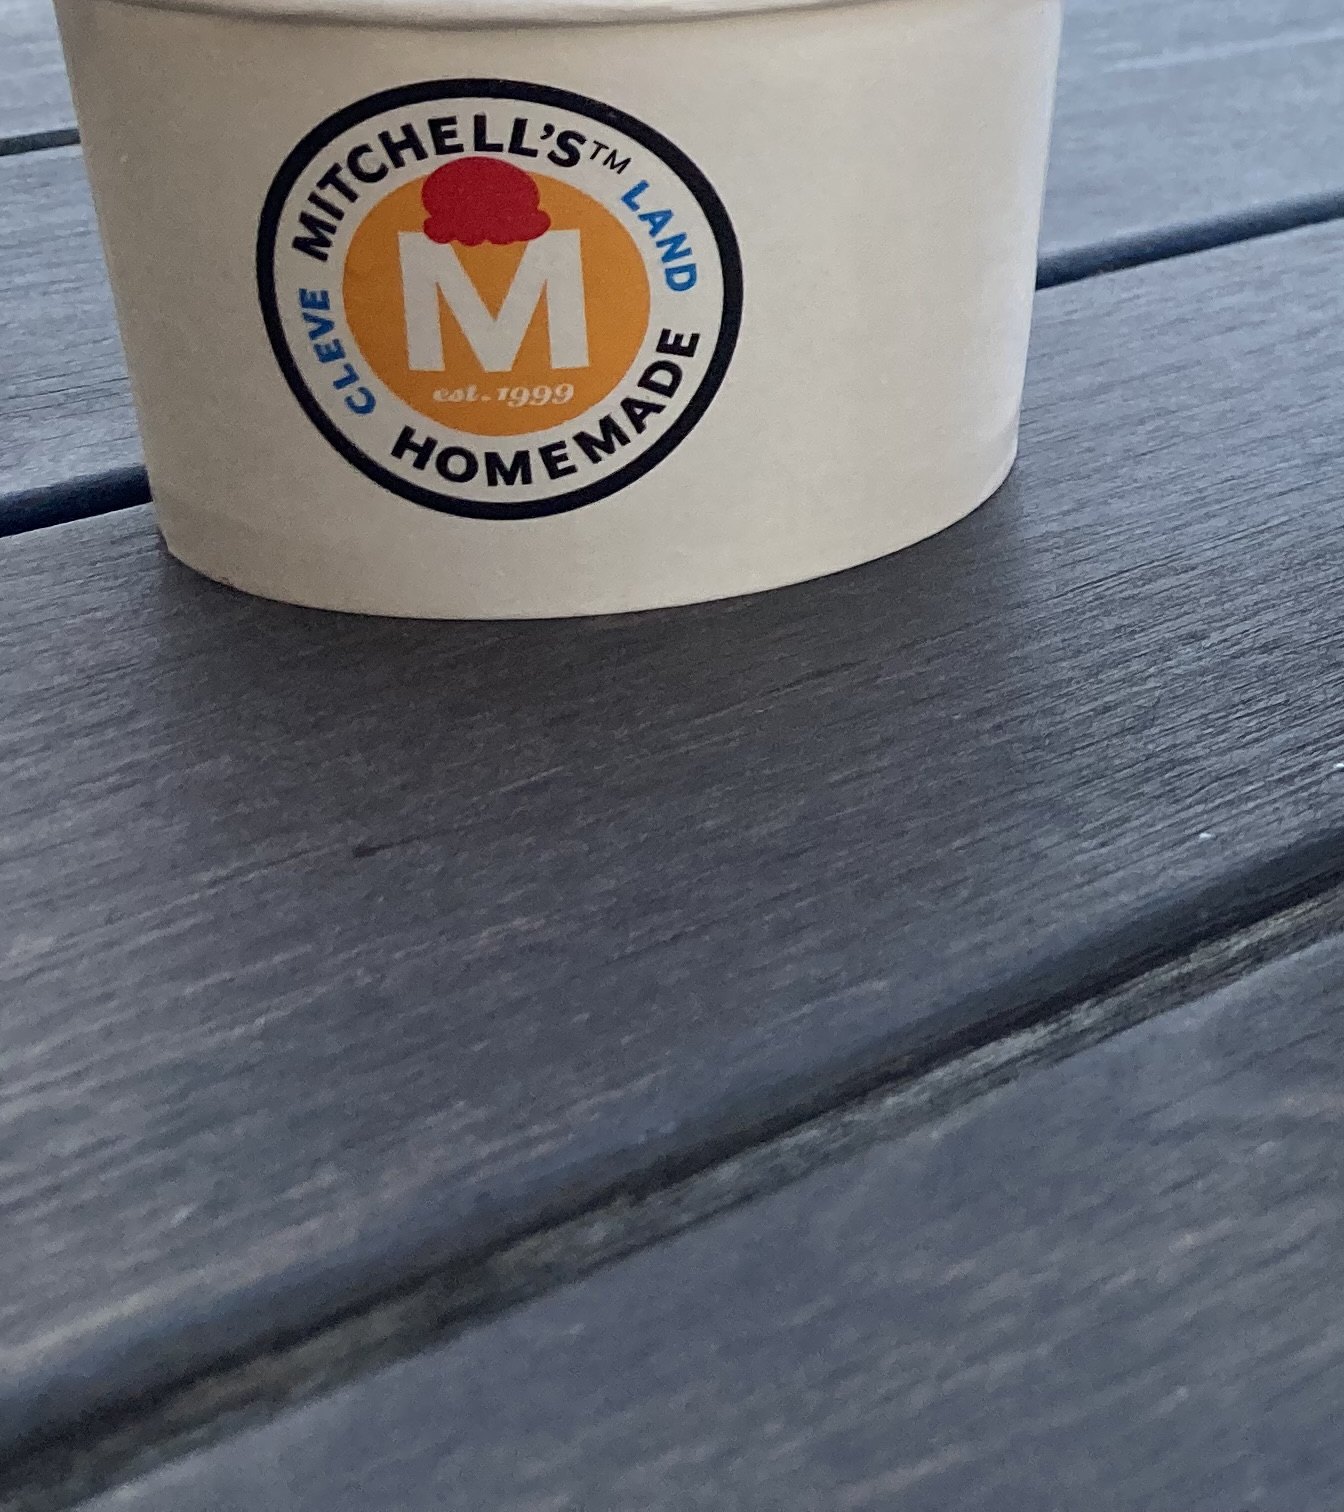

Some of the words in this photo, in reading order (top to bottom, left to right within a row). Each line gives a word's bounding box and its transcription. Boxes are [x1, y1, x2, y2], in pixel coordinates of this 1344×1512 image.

[291, 113, 588, 263] MITCHELL'S
[298, 287, 377, 417] CLEVE
[620, 179, 698, 293] LAND
[397, 229, 590, 373] M
[390, 325, 701, 487] HOMEMADE
